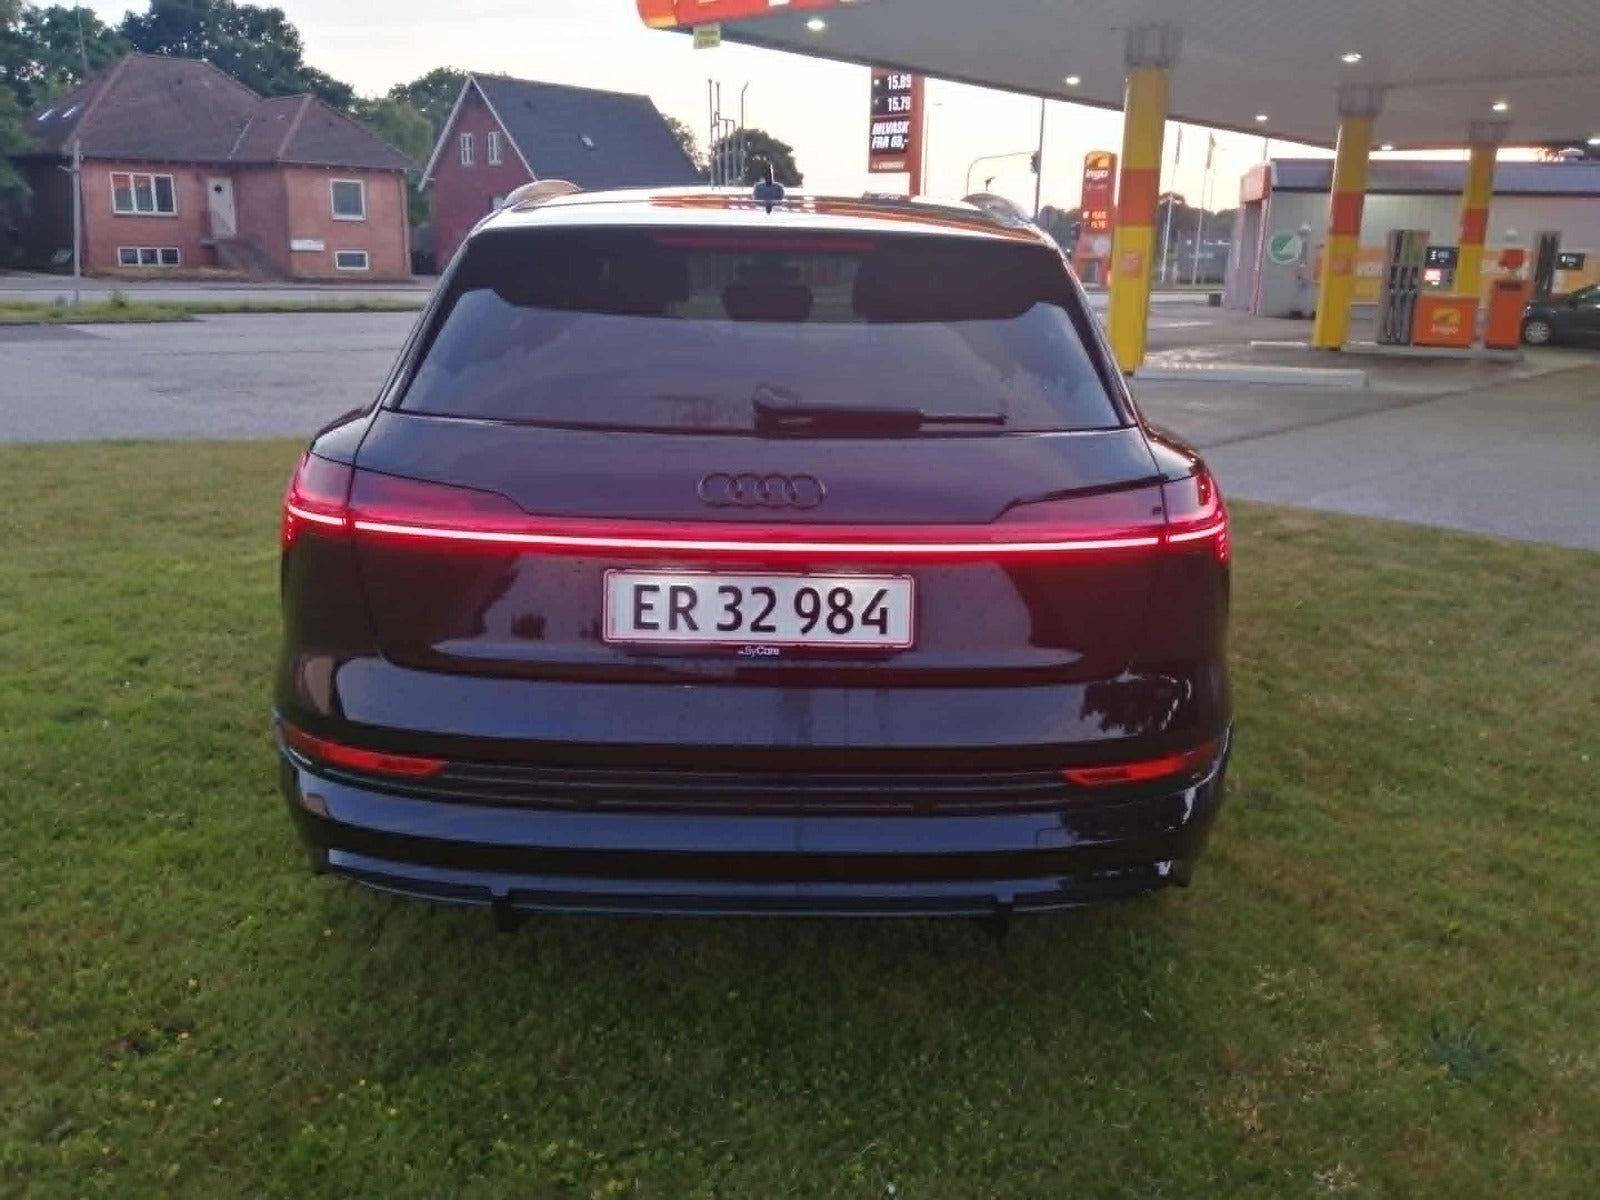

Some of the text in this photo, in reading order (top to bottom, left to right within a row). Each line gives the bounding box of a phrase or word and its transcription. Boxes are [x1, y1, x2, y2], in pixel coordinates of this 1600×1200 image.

[632, 584, 888, 635] ER 32 984
